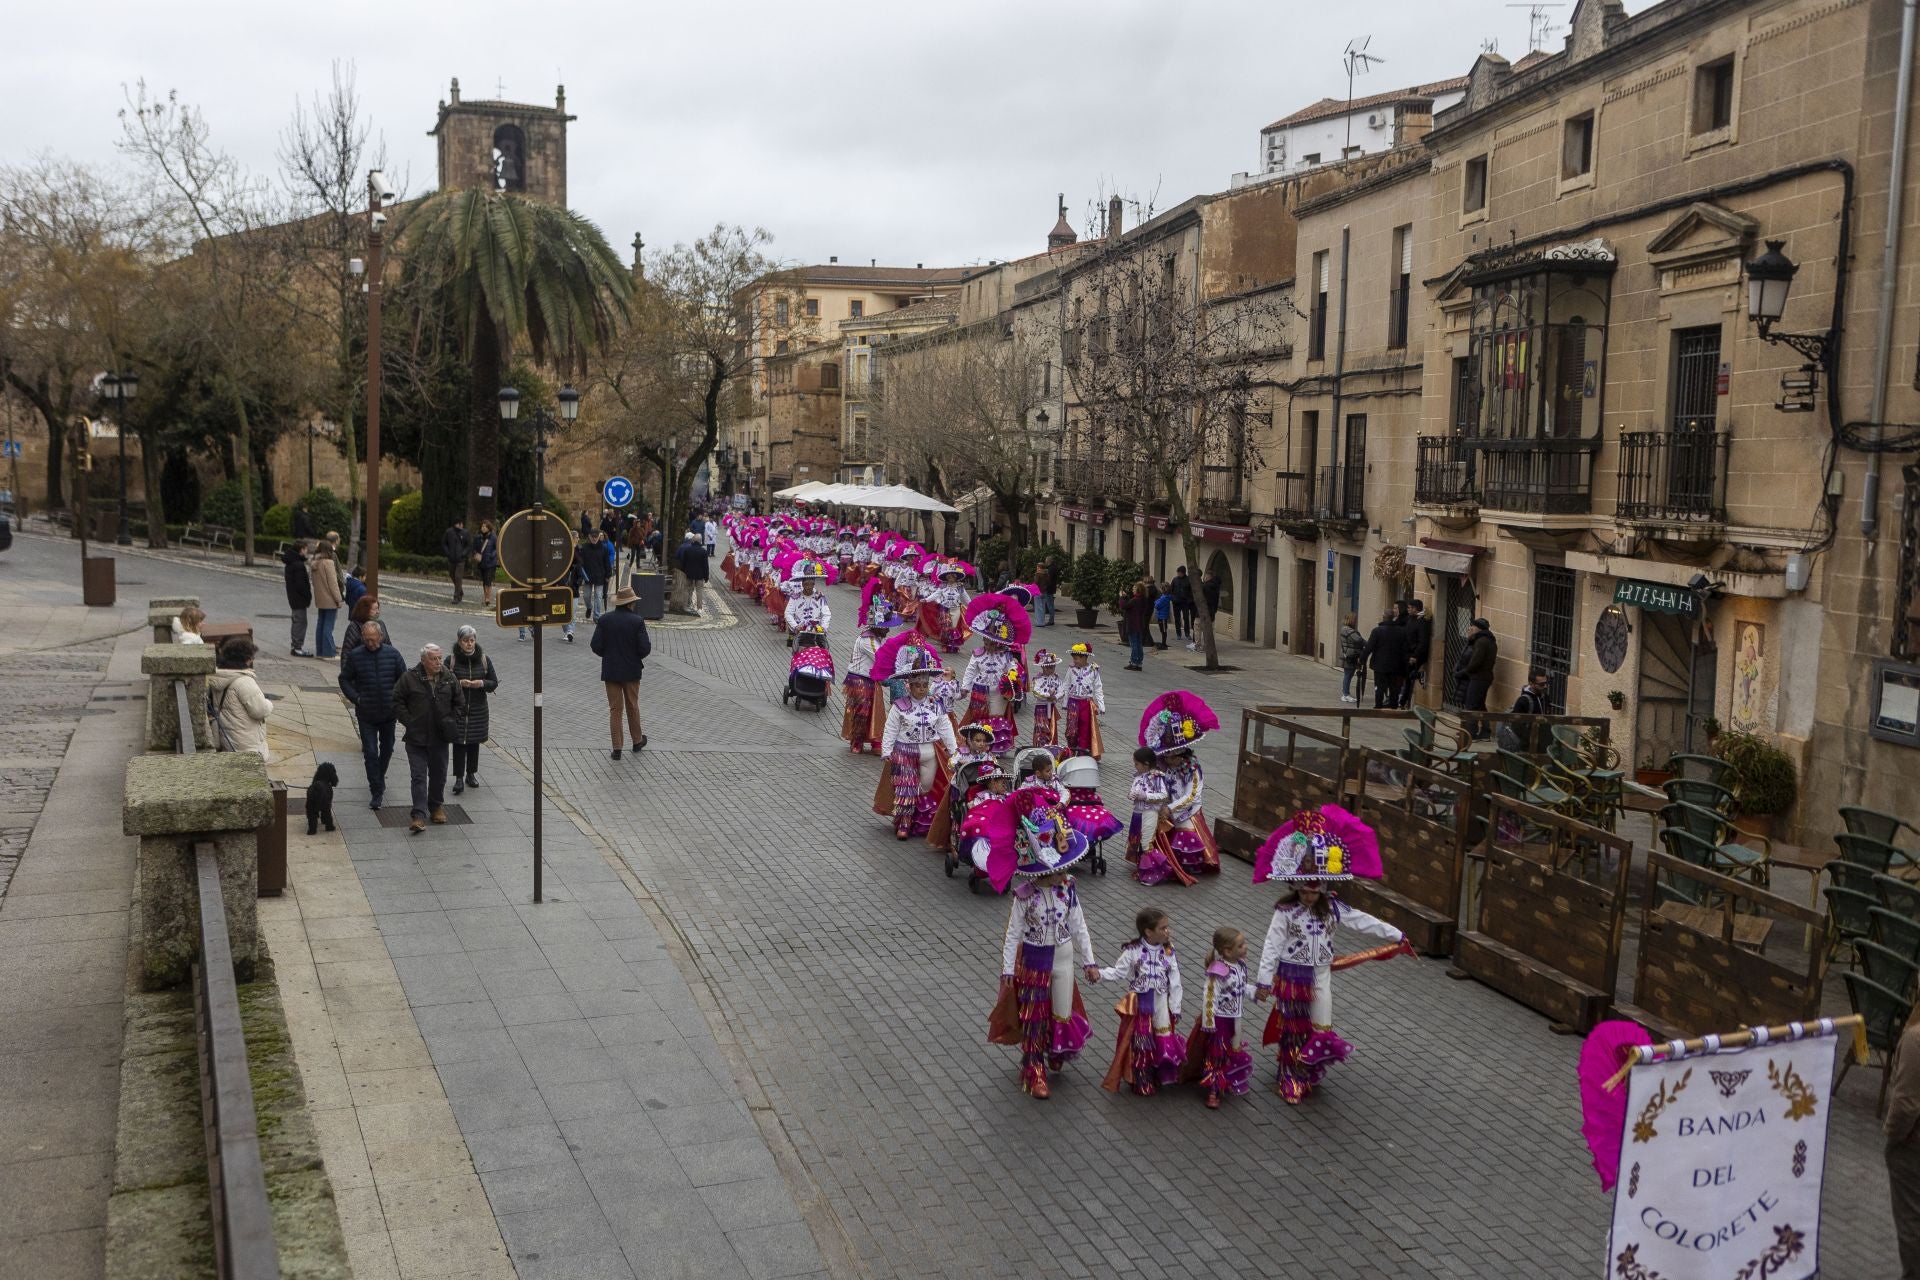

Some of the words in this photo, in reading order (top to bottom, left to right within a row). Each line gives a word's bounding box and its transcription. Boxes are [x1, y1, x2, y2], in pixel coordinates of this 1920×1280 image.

[1618, 583, 1692, 611] ARTESANIA
[1678, 1108, 1766, 1136] BANDA
[1692, 1164, 1736, 1188] DEL
[1640, 1190, 1779, 1252] COLORETE
